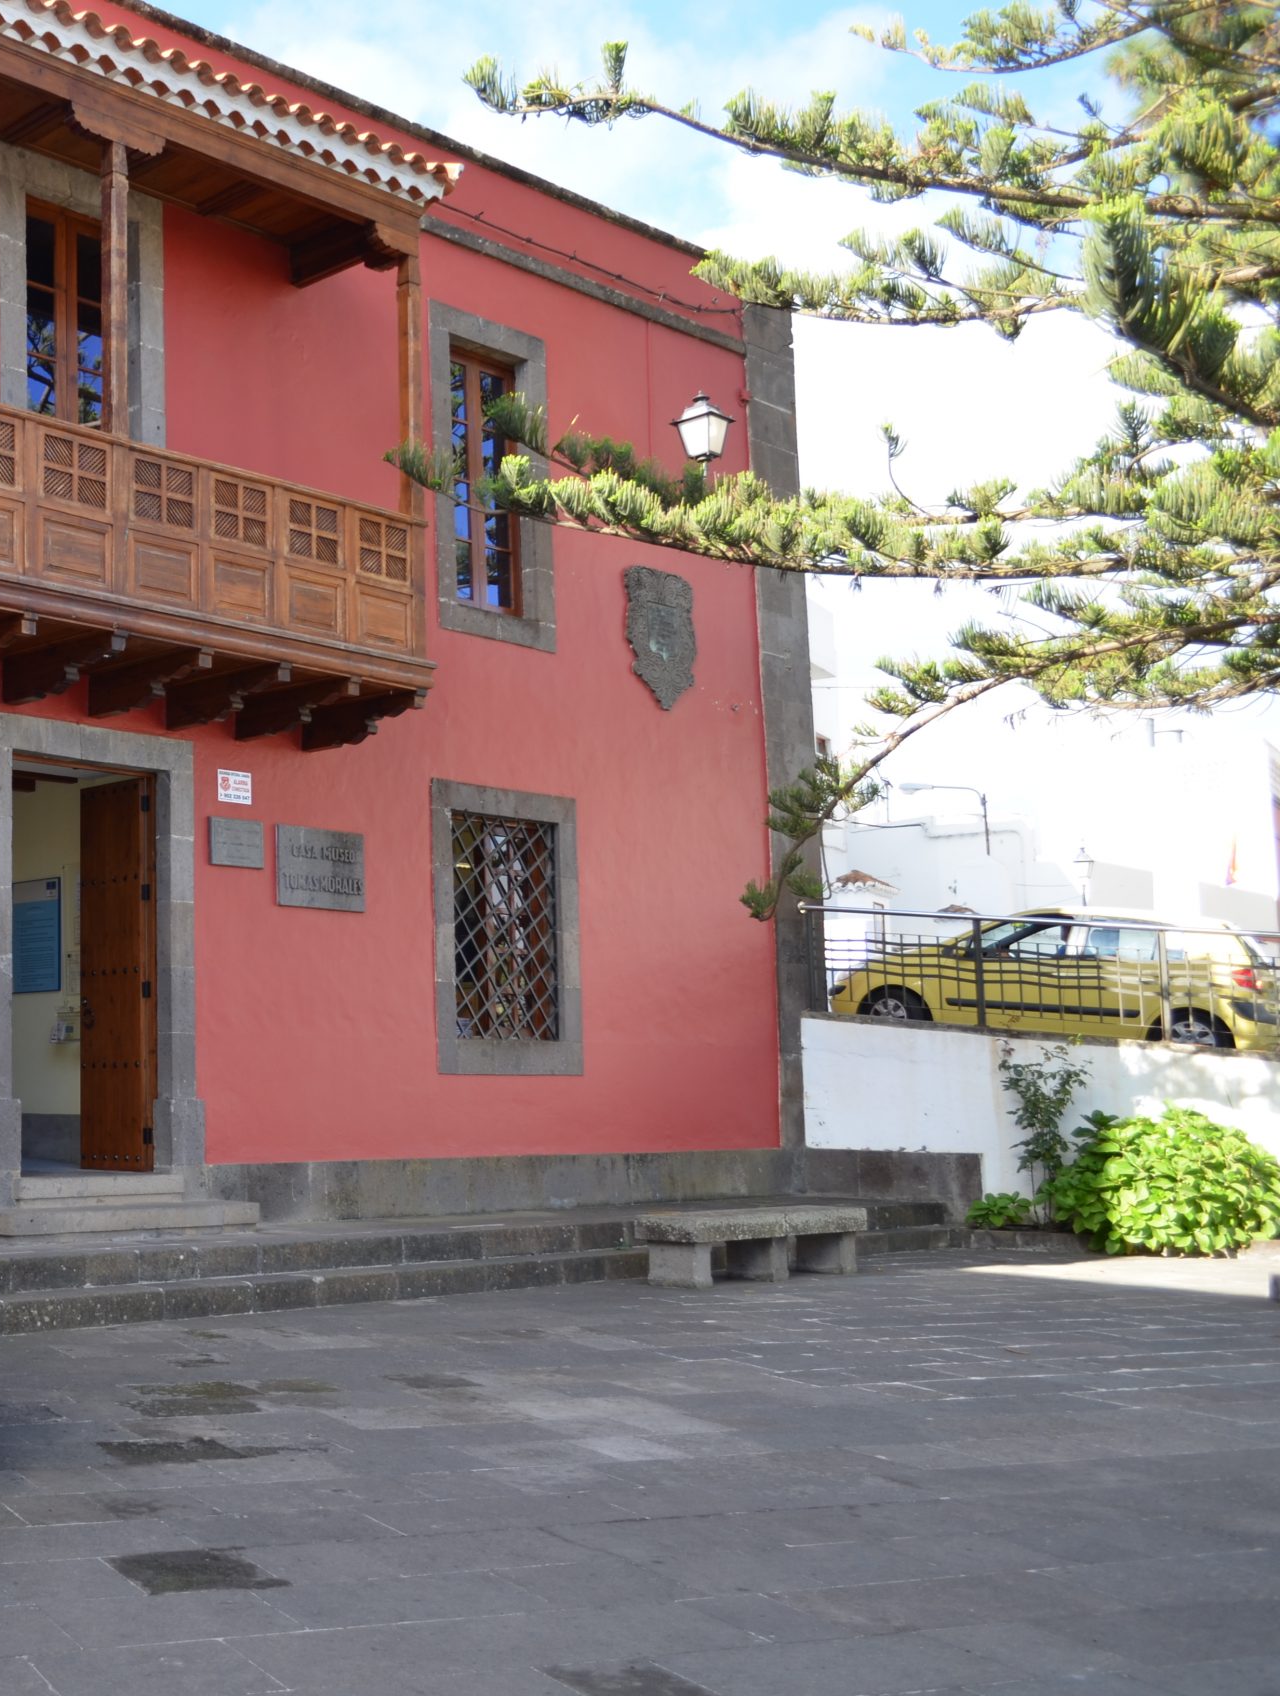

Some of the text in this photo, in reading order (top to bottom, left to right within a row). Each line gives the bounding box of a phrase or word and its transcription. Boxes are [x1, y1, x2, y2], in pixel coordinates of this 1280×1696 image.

[291, 844, 356, 864] CASA MUSEO
[320, 876, 363, 897] MORALES
